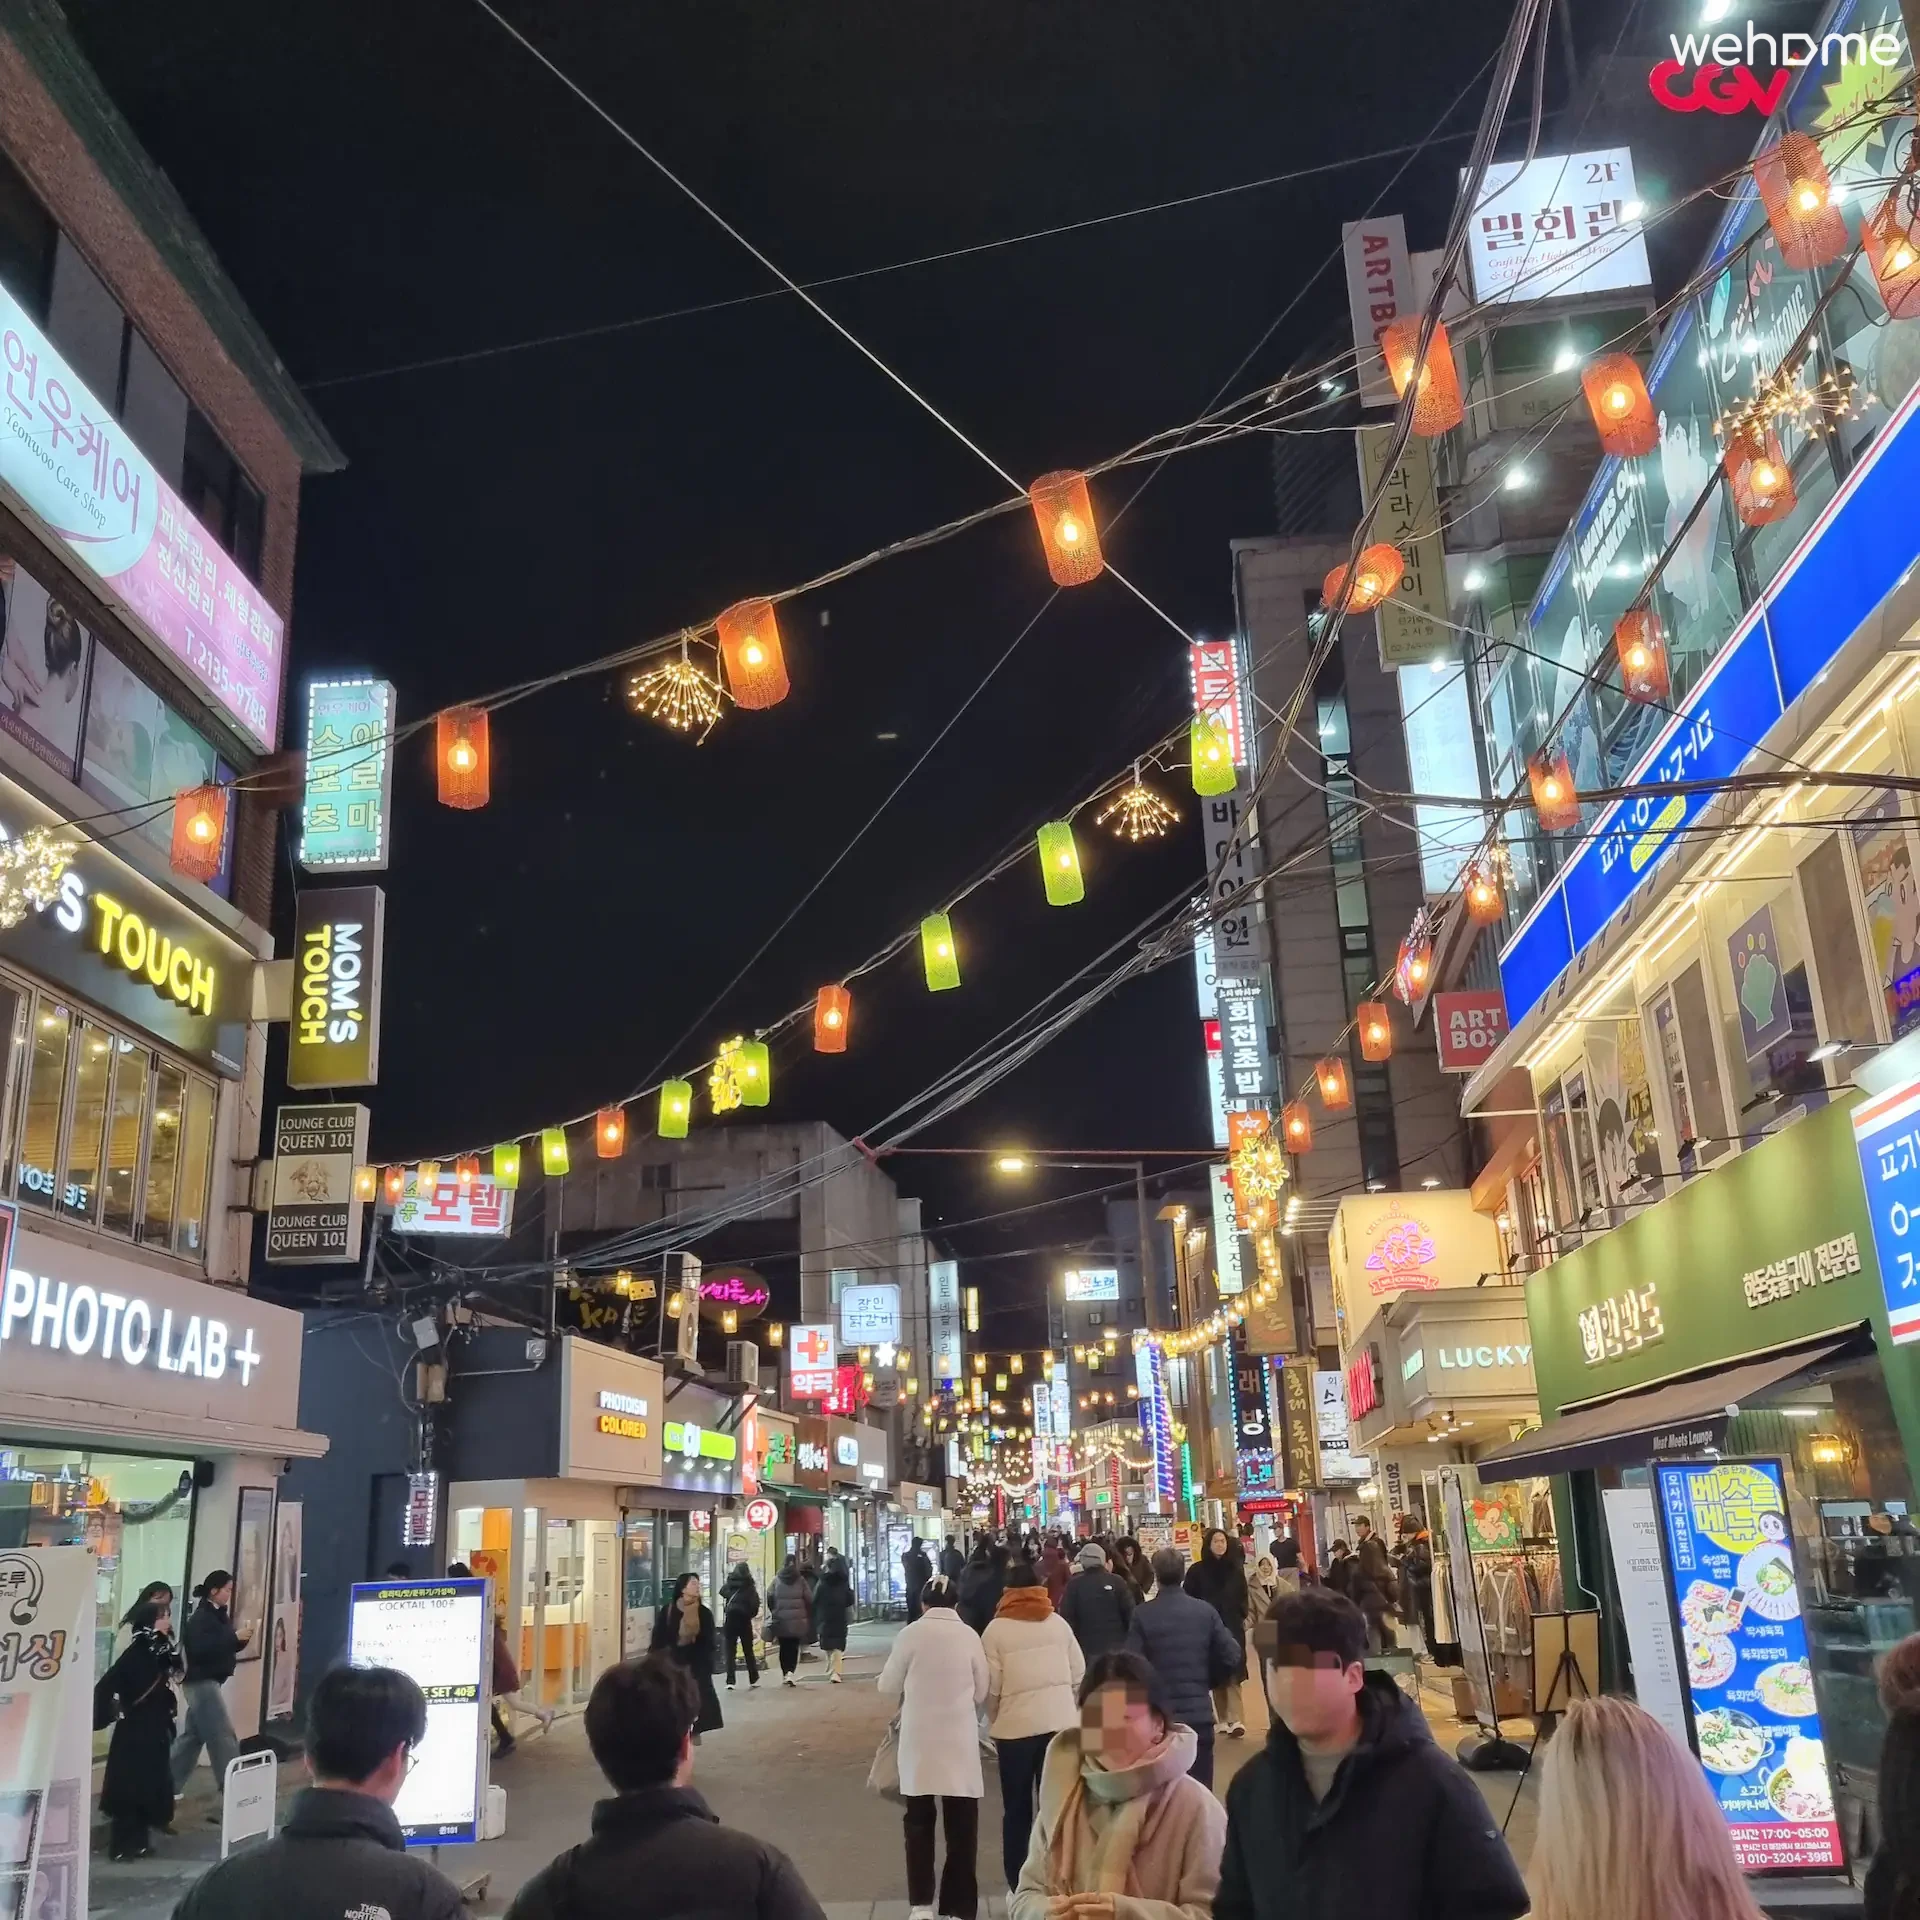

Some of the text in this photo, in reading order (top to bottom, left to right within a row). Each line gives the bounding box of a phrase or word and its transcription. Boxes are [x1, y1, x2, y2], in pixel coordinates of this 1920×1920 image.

[1648, 59, 1791, 117] CGV
[1584, 161, 1621, 184] 2F
[1482, 199, 1632, 251] 밀회관
[4, 406, 107, 530] Yeonwoo Care Shop
[307, 724, 344, 834] 스포츠
[346, 719, 383, 833] 아로마
[95, 892, 216, 1017] TOUCH
[299, 923, 332, 1045] TOUCH
[329, 922, 364, 1044] MOM'S
[1449, 1007, 1500, 1030] ART
[1228, 1000, 1264, 1095] 회전초밥
[279, 1114, 355, 1131] LOUNGE CLUB
[278, 1133, 353, 1151] QUEEN 101
[423, 1182, 503, 1228] 모텔
[271, 1213, 347, 1229] LOUNGE CLUB
[270, 1231, 346, 1251] QUEEN 101
[1742, 1231, 1862, 1308] 한돈숯불구이 전문점
[858, 1297, 884, 1311] 장인
[1, 1269, 152, 1366] PHOTO
[158, 1307, 229, 1380] LAB
[848, 1312, 893, 1329] 닭갈비
[1438, 1343, 1532, 1369] LUCKY
[792, 1372, 833, 1394] 약국
[600, 1415, 647, 1439] COLORED
[1667, 1474, 1684, 1512] 오사카
[1687, 1473, 1780, 1513] 베스트
[749, 1500, 771, 1526] 약
[1694, 1503, 1758, 1541] 메뉴
[378, 1600, 426, 1611] COCKTAIL
[430, 1686, 453, 1698] SET
[1739, 1785, 1768, 1797] 소고기
[1761, 1827, 1829, 1840] 17:00~05:00
[1747, 1851, 1834, 1864] 010-3204-3981
[360, 1902, 379, 1915] THE
